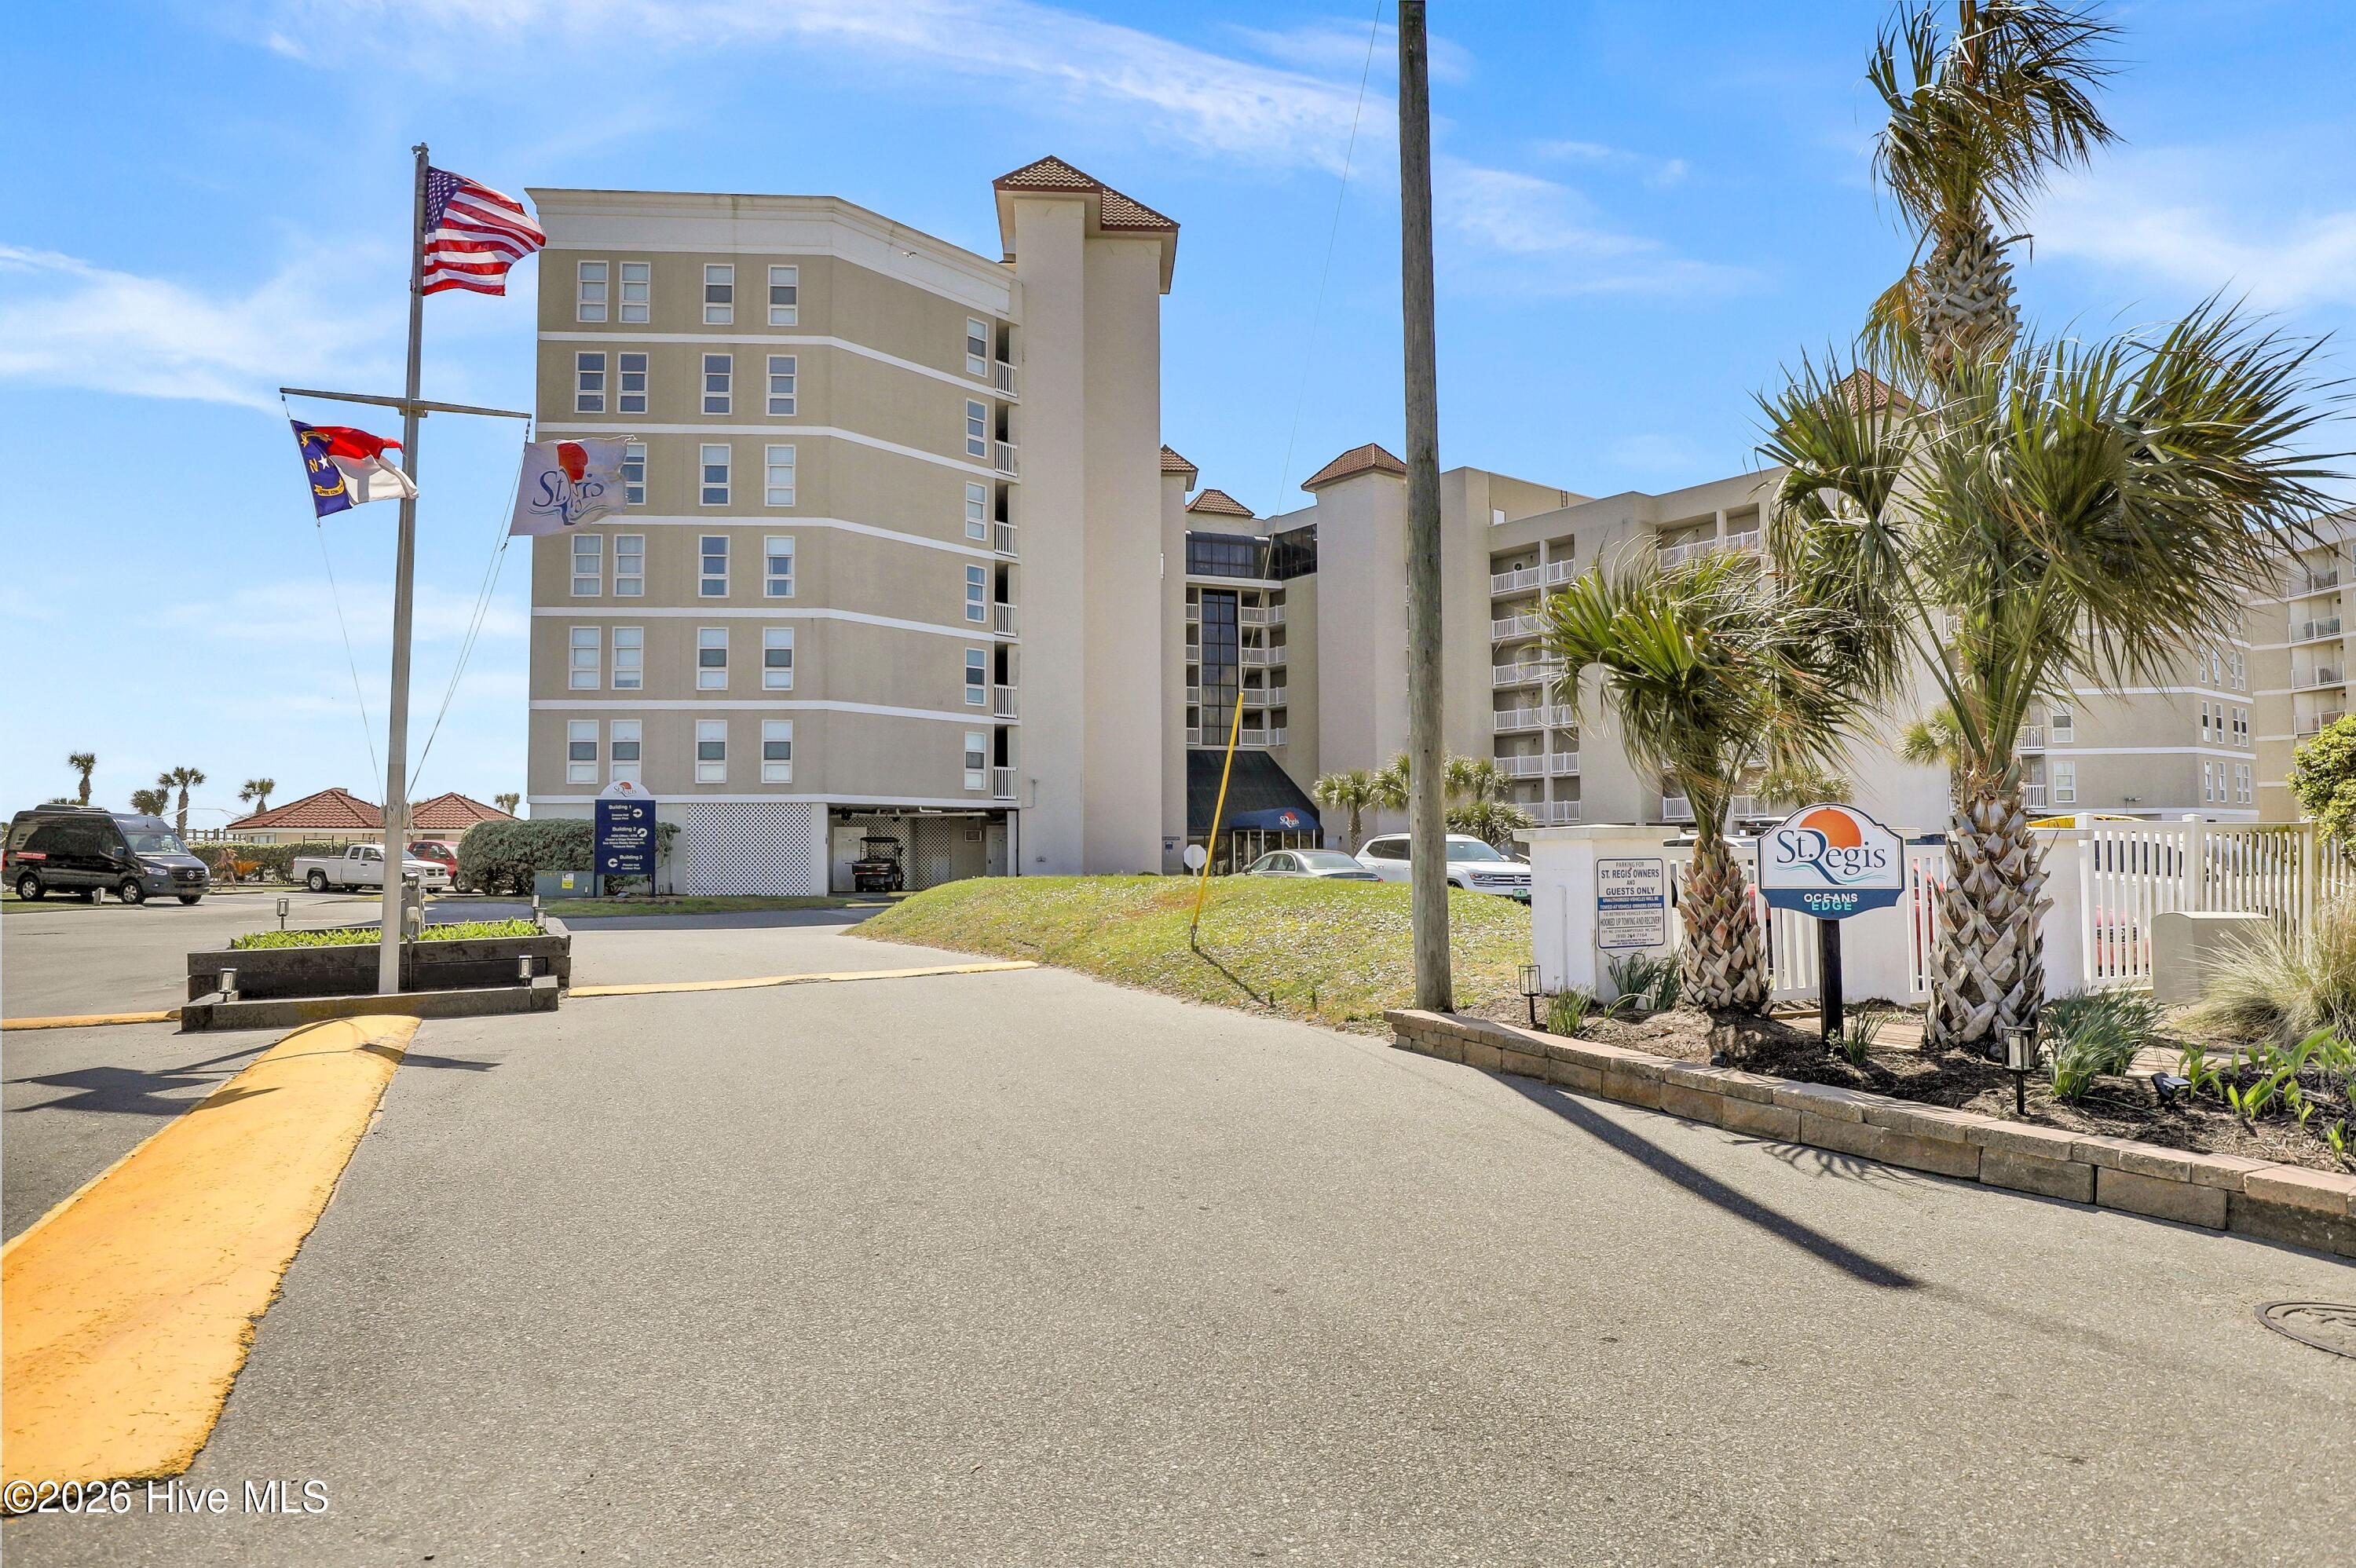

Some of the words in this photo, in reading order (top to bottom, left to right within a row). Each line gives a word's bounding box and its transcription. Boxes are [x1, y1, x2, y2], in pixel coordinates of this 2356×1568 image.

[532, 470, 566, 507] St.
[1776, 830, 1813, 864] St.
[1798, 830, 1886, 886] Regis
[1601, 869, 1611, 879] ST.
[1612, 869, 1631, 879] REGIS
[1633, 868, 1659, 878] OWNERS
[1606, 887, 1634, 896] GUESTS
[1803, 893, 1858, 903] OCEANS
[1811, 901, 1852, 911] EDGE
[1601, 918, 1615, 927] HOOKED
[1615, 917, 1621, 926] UP
[1621, 917, 1636, 926] TOWING
[1644, 916, 1662, 925] RECOVERY
